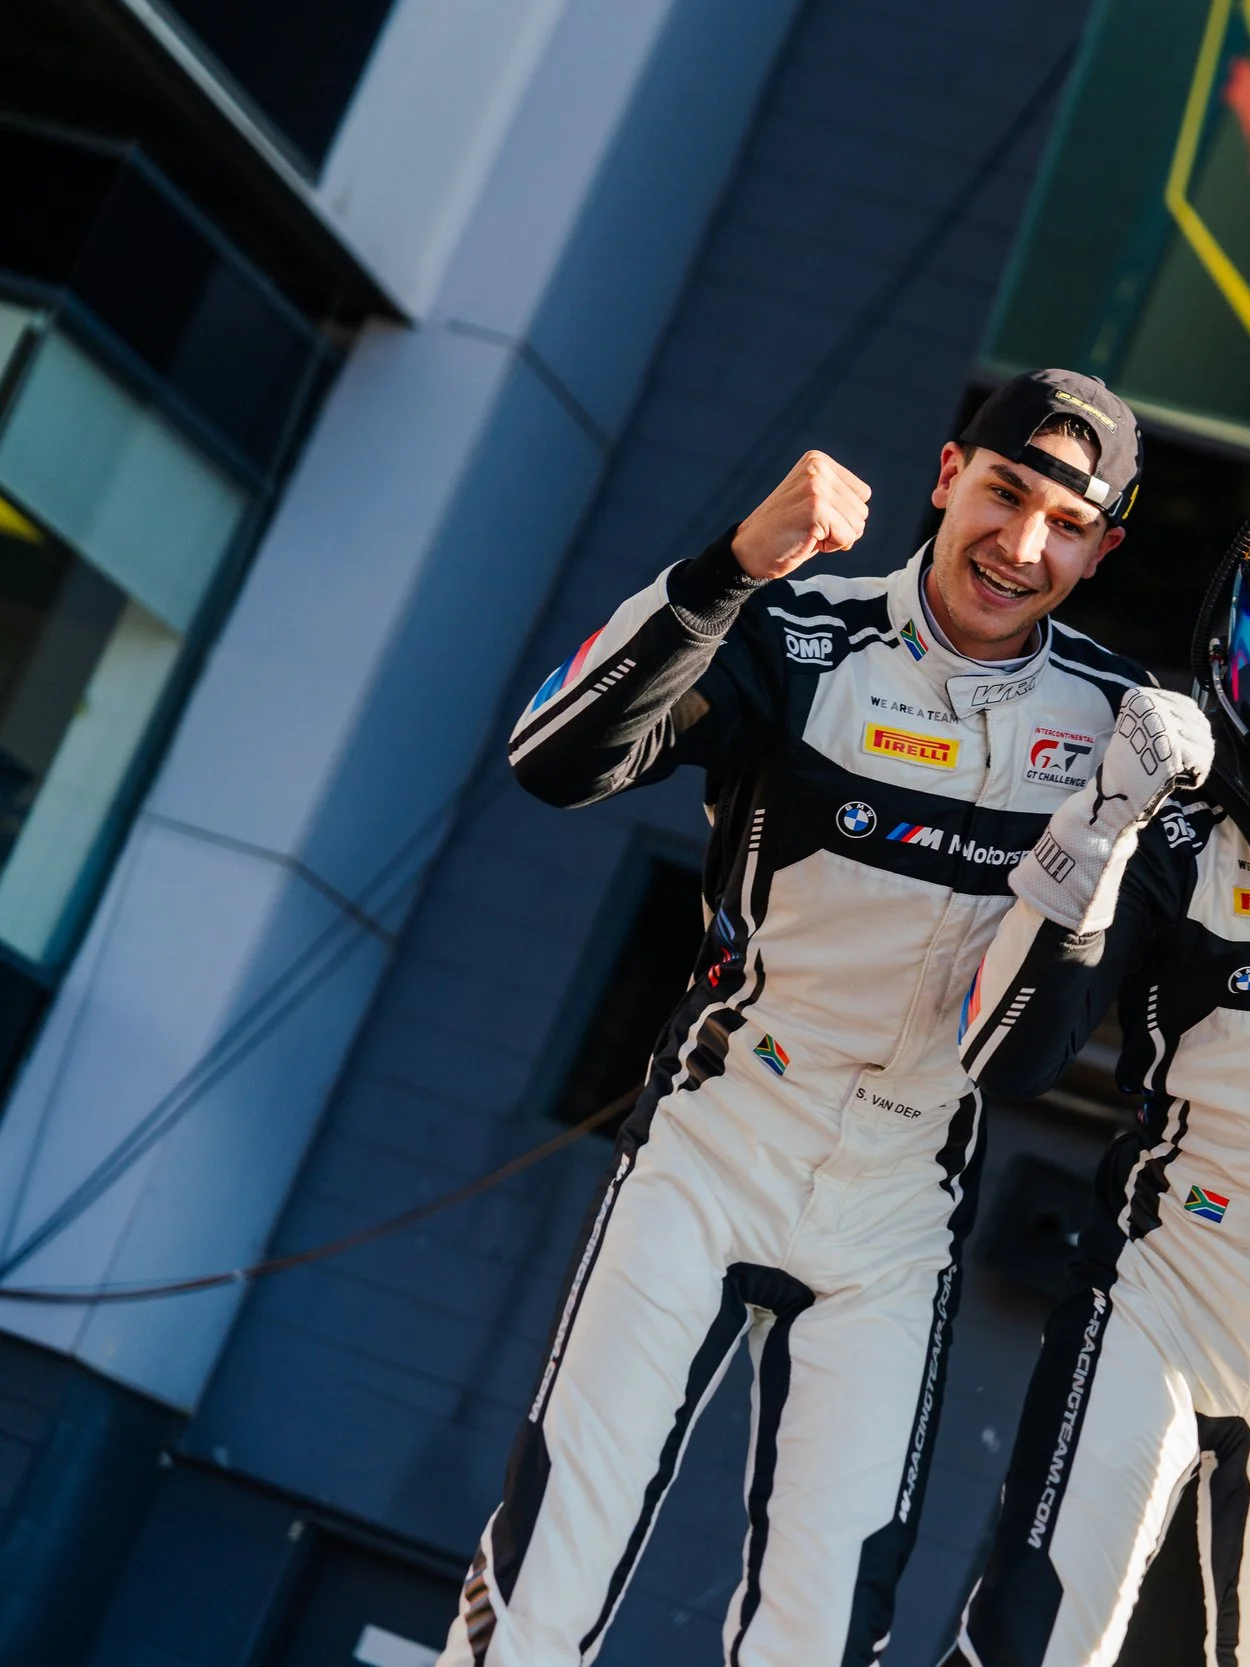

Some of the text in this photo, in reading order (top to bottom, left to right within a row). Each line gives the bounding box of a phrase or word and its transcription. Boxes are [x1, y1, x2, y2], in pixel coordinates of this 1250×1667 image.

[785, 634, 834, 659] OMP
[870, 695, 959, 725] WE ARE A TEAM
[873, 729, 951, 762] PIRELLI
[1034, 727, 1095, 744] INTERCONTINENTAL
[1026, 769, 1087, 788] GT CHALLENGE
[856, 1087, 922, 1119] S. VAN DER
[1027, 1287, 1107, 1549] W-RACINGTEAM.COM
